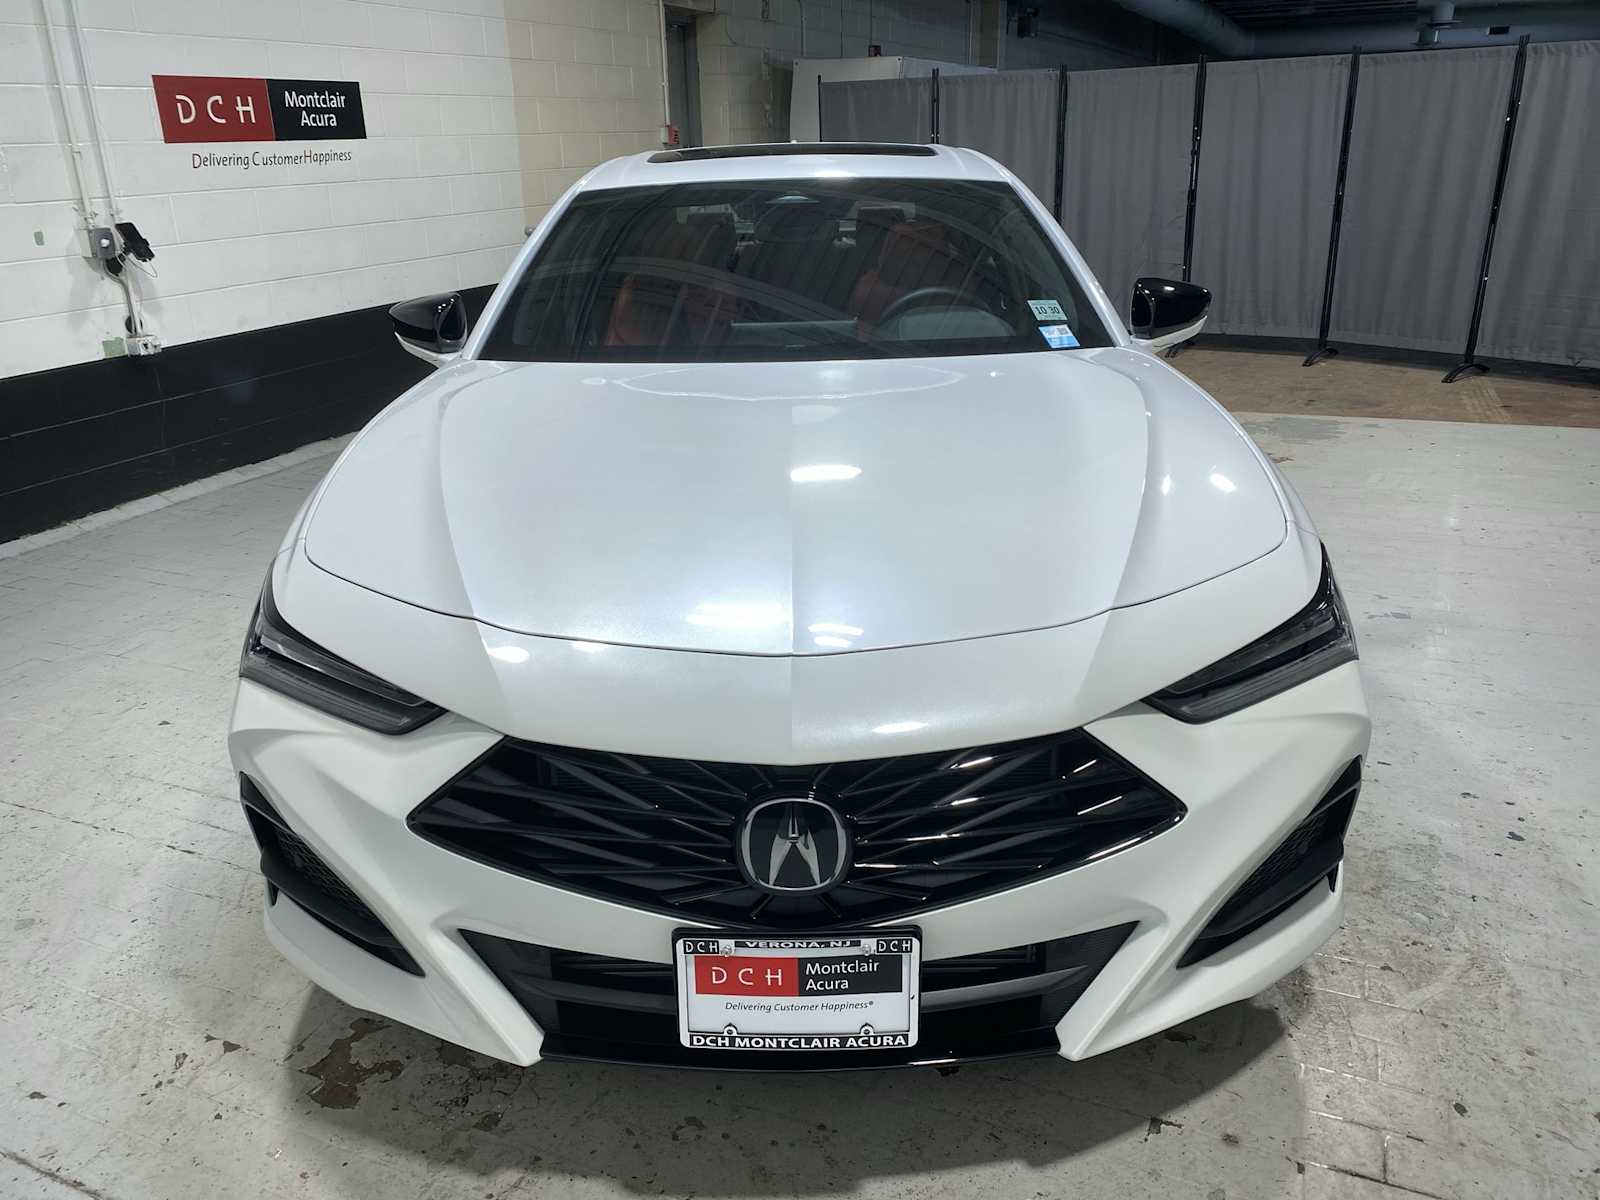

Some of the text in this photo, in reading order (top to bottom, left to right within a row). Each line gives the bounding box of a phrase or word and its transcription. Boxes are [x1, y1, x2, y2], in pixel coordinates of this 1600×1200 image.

[284, 91, 347, 108] Montclair
[301, 110, 338, 127] Acura
[192, 149, 352, 169] Delivering Customer Happiness
[684, 941, 719, 953] DCH
[877, 941, 912, 952] DCH
[805, 959, 880, 975] Montclair
[711, 966, 783, 986] DCH
[805, 977, 849, 991] Acura
[725, 1001, 772, 1013] Delivering
[773, 1002, 819, 1012] Customer
[692, 1034, 907, 1049] DCH MONTCLAIR ACURA
